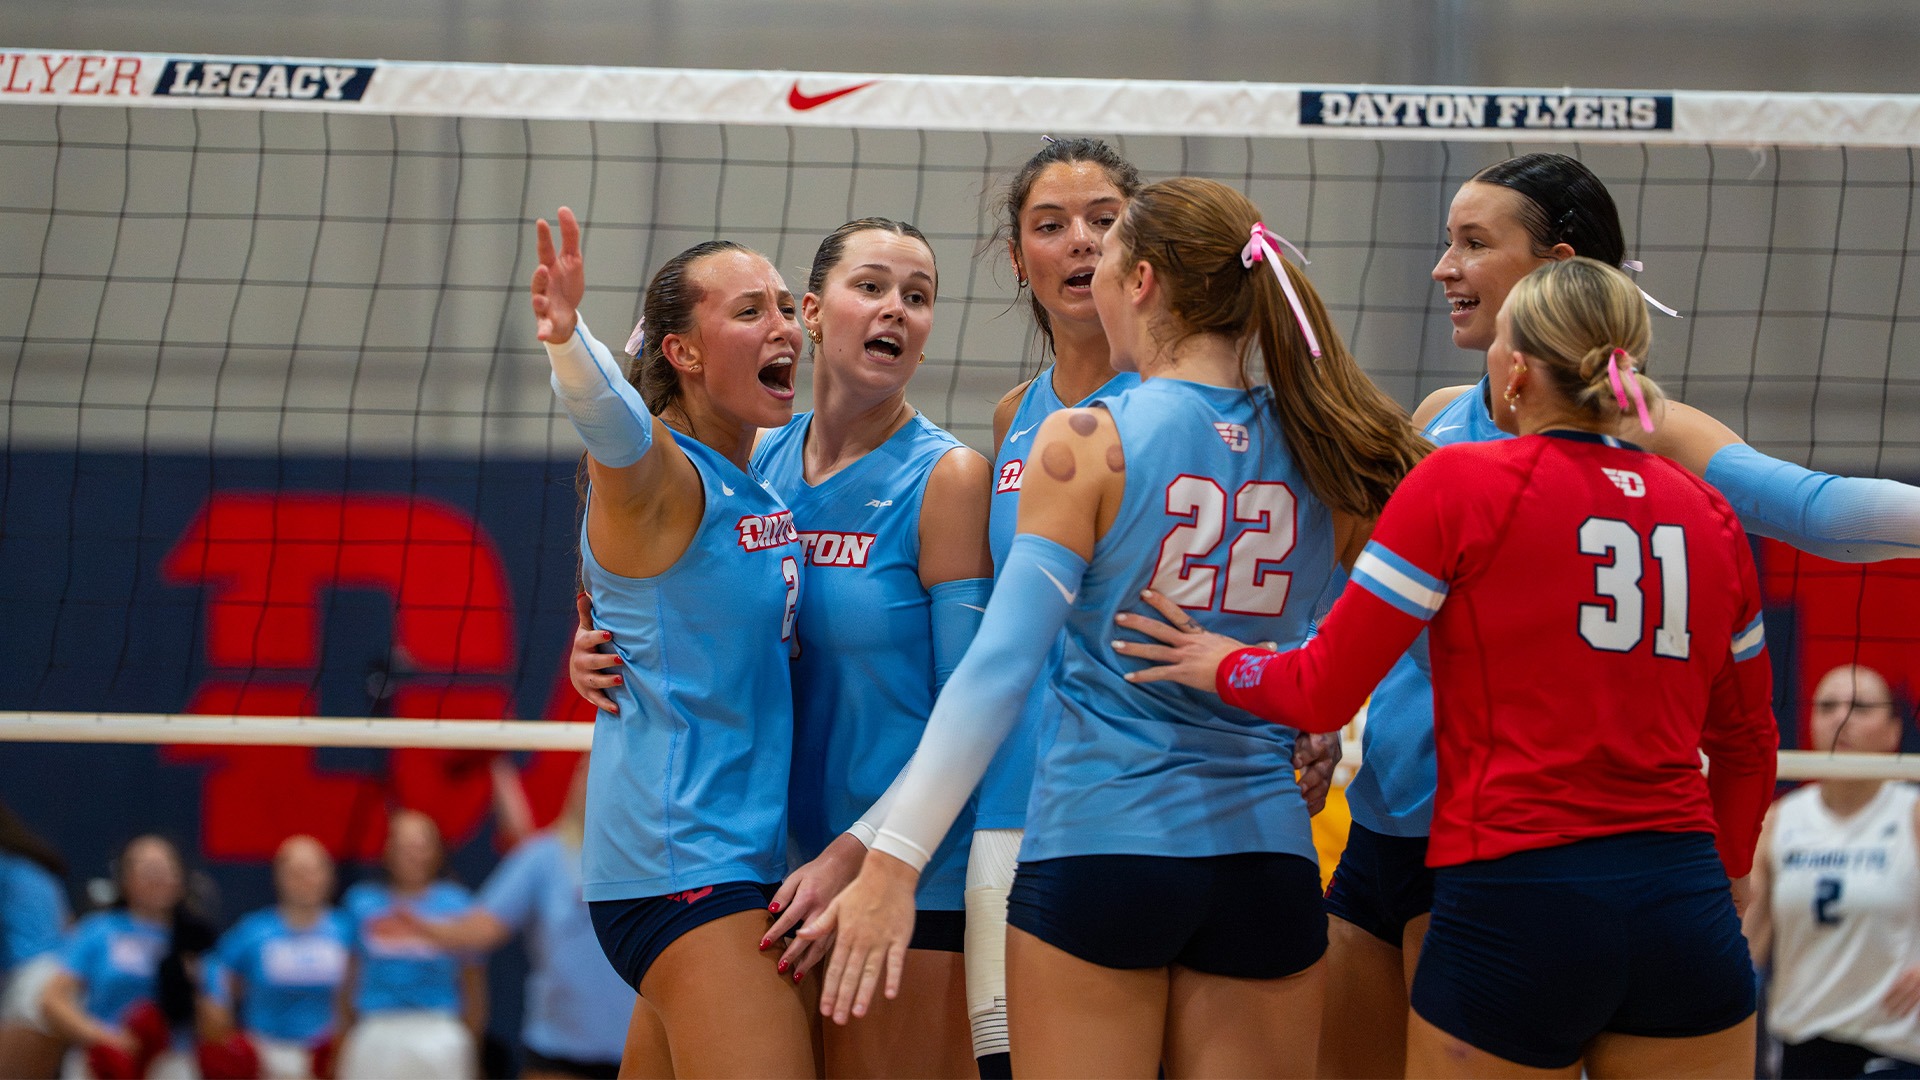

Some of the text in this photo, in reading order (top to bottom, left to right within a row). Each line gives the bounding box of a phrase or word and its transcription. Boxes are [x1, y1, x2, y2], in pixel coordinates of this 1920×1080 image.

[0, 53, 357, 99] LYER LEGACY
[1320, 92, 1657, 129] DAYTON FLYERS
[1148, 473, 1298, 617] 22
[781, 556, 799, 642] 2
[1578, 516, 1692, 662] 31
[1813, 877, 1844, 925] 2
